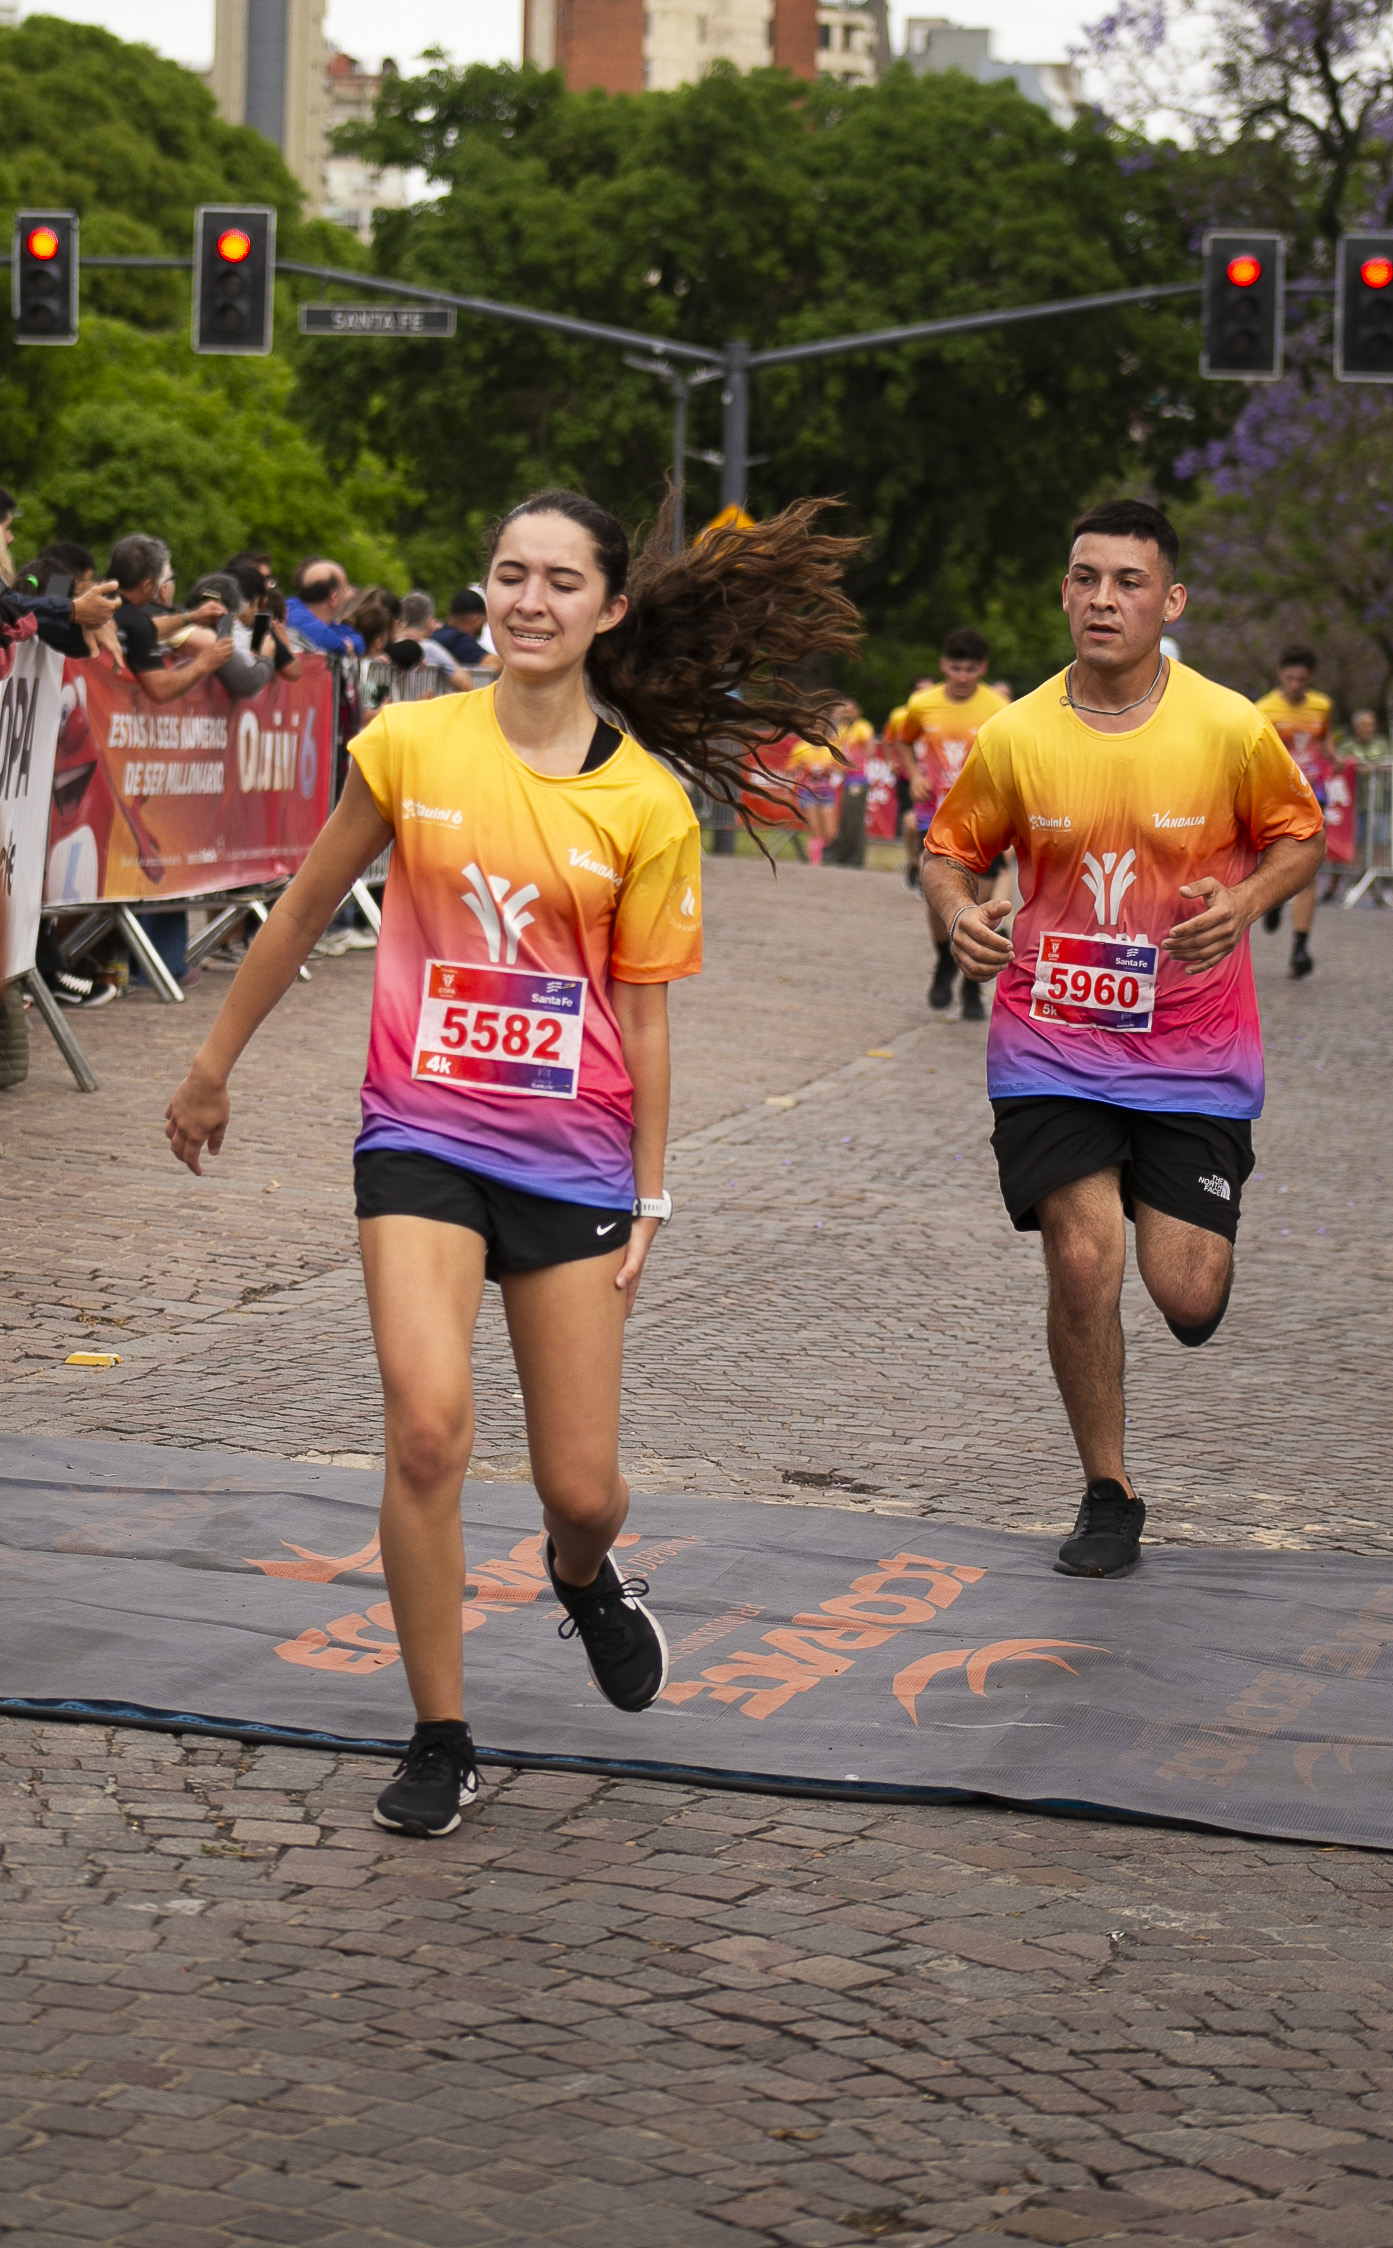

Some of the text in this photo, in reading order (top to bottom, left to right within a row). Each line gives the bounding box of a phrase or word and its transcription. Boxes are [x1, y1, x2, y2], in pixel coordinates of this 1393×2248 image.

[331, 311, 424, 331] SANTA FE
[157, 714, 179, 749] SEIS
[301, 706, 317, 799] 6
[124, 761, 142, 796] DE
[143, 761, 166, 795] SER
[452, 809, 463, 825] 6
[1063, 815, 1072, 828] 6
[1152, 810, 1205, 828] VANDALIA
[1115, 957, 1148, 968] Santa Fe
[1048, 967, 1139, 1009] 5960
[531, 993, 573, 1008] Santa Fe
[1042, 1003, 1057, 1016] 5k
[440, 1007, 563, 1061] 5582
[425, 1055, 452, 1074] 4k
[1198, 1176, 1222, 1191] NORTH
[1212, 1174, 1224, 1185] THE
[1203, 1185, 1221, 1197] FACE
